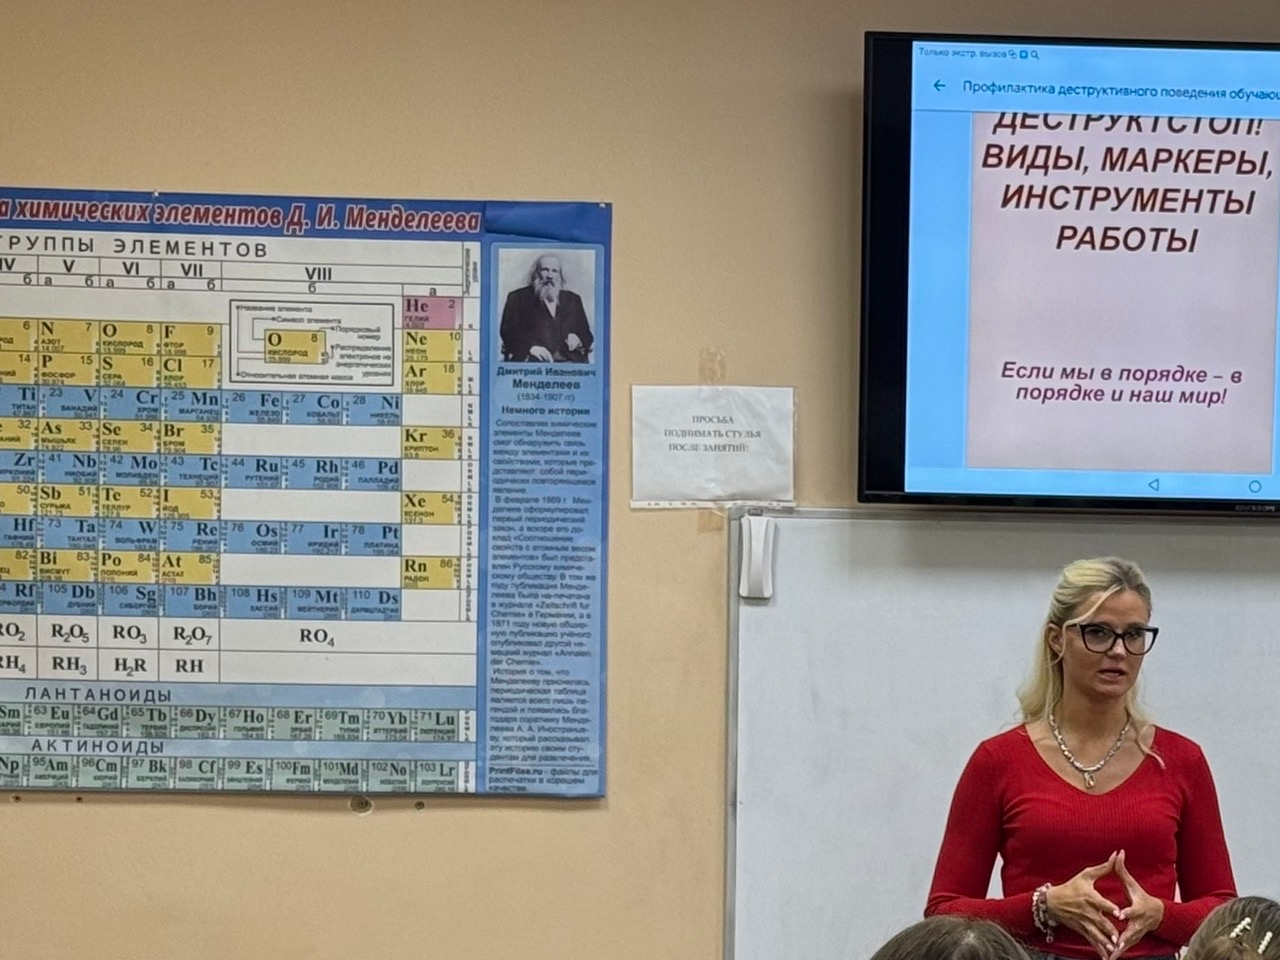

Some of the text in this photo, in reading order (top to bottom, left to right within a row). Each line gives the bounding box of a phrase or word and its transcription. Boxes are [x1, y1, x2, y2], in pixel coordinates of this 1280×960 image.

[919, 47, 949, 57] Только
[963, 80, 1055, 96] Профилактика
[1058, 84, 1157, 98] деструктивного
[1161, 88, 1226, 99] поведения
[992, 112, 1264, 136] ДЕСТРУКТСТОП!
[981, 143, 1089, 176] ВИДЫ,
[1100, 147, 1273, 180] МАРКЕРЫ,
[1001, 184, 1256, 215] ИНСТРУМЕНТЫ
[15, 200, 151, 222] химических
[154, 203, 283, 228] элементов
[284, 203, 311, 235] Д.
[315, 203, 340, 229] И.
[344, 204, 481, 233] Менделеева
[1056, 225, 1199, 253] РАБОТЫ
[113, 238, 267, 258] ЭЛЕМЕНТОВ
[63, 260, 75, 272] V
[123, 262, 139, 275] VI
[181, 263, 203, 277] VII
[305, 267, 332, 281] VIII
[406, 298, 428, 313] He
[41, 322, 55, 336] N
[102, 324, 117, 338] O
[164, 326, 176, 339] F
[268, 333, 281, 346] O
[406, 332, 427, 345] Ne
[449, 333, 461, 341] 10
[41, 355, 53, 368] P
[102, 357, 113, 370] S
[164, 358, 182, 372] Cl
[405, 364, 426, 377] Ar
[496, 367, 597, 377] Дмитрий Иванович
[1000, 361, 1055, 380] Если
[1060, 366, 1095, 380] мы
[1100, 367, 1113, 381] в
[1118, 365, 1208, 386] порядке
[1230, 370, 1243, 384] в
[512, 379, 581, 390] Менделеев
[18, 387, 36, 401] Ti
[51, 388, 97, 402] 23 V
[111, 389, 158, 404] 24 Cr
[172, 390, 218, 406] 25 Mn
[261, 394, 279, 407] Fe
[1016, 384, 1228, 408] порядке и наш мир!
[317, 395, 339, 409] Co
[382, 396, 399, 409] Ni
[501, 405, 591, 416] Немного истории
[692, 415, 734, 424] ПРОСЬБА
[41, 421, 62, 434] As
[164, 424, 184, 437] Br
[664, 429, 762, 439] ПОДНИМАТЬ СТУЛЬЯ
[404, 429, 427, 442] Kr
[668, 443, 700, 452] ПОСЛЕ
[15, 453, 35, 466] Zr
[73, 454, 96, 468] Nb
[131, 456, 157, 469] Mo
[200, 458, 218, 471] Tc
[256, 458, 278, 472] Ru
[317, 460, 338, 473] Rh
[378, 461, 398, 474] Pd
[40, 486, 61, 500] Sb
[14, 518, 35, 531] Hf
[75, 520, 95, 533] Ta
[139, 522, 156, 534] W
[256, 524, 278, 537] Os
[323, 525, 338, 539] Ir
[382, 526, 398, 539] Pt
[40, 552, 56, 565] Bi
[102, 554, 121, 566] Po
[162, 555, 181, 568] At
[404, 559, 426, 572] Rn
[15, 584, 36, 597] Rf
[72, 585, 94, 598] Db
[136, 587, 156, 602] Sg
[195, 588, 216, 601] Bh
[256, 589, 277, 602] Hs
[315, 590, 338, 604] Mt
[353, 590, 398, 605] 110 Ds
[176, 659, 204, 673] RH
[25, 687, 171, 704] ЛАНТАНОИДЫ
[51, 707, 69, 720] Eu
[97, 707, 118, 721] Gd
[149, 708, 167, 722] Tb
[196, 709, 216, 726] Dy
[242, 710, 264, 723] Ho
[294, 711, 313, 724] Er
[340, 711, 360, 725] Tm
[387, 712, 407, 726] Yb
[420, 711, 455, 726] 71 Lu
[32, 739, 164, 756] АКТИНОИДЫ
[48, 758, 68, 772] Am
[96, 759, 118, 773] Cm
[149, 760, 167, 774] Bk
[198, 760, 216, 774] Cf
[246, 761, 263, 775] Es
[292, 762, 311, 776] Fm
[339, 763, 359, 776] Md
[389, 763, 407, 776] No
[420, 763, 455, 776] 103 Lr
